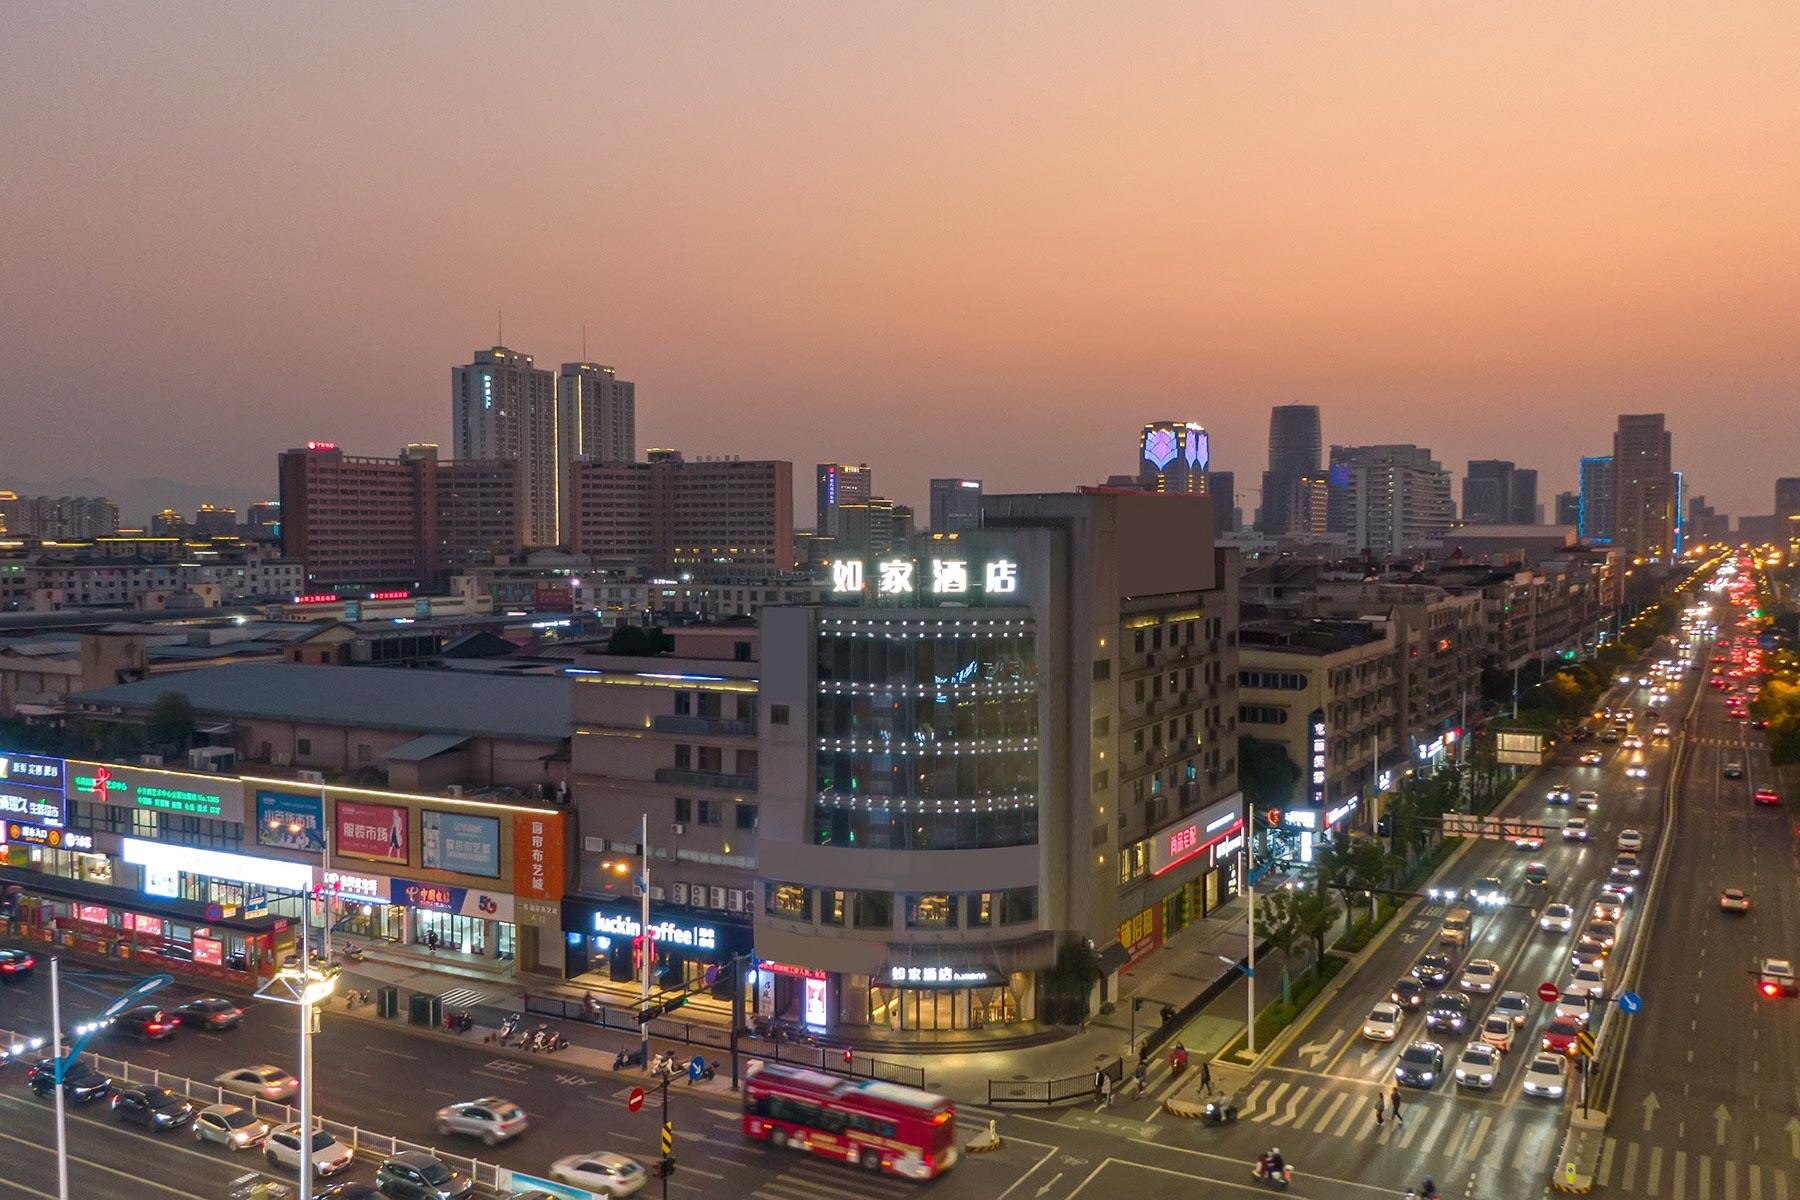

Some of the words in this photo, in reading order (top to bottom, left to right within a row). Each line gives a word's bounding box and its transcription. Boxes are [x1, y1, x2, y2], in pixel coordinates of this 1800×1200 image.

[833, 560, 1017, 593] 如家酒店
[343, 822, 388, 842] 服装市场
[532, 821, 544, 890] 窗帘布艺城
[595, 911, 641, 936] luckin
[892, 966, 952, 981] 如家酒店
